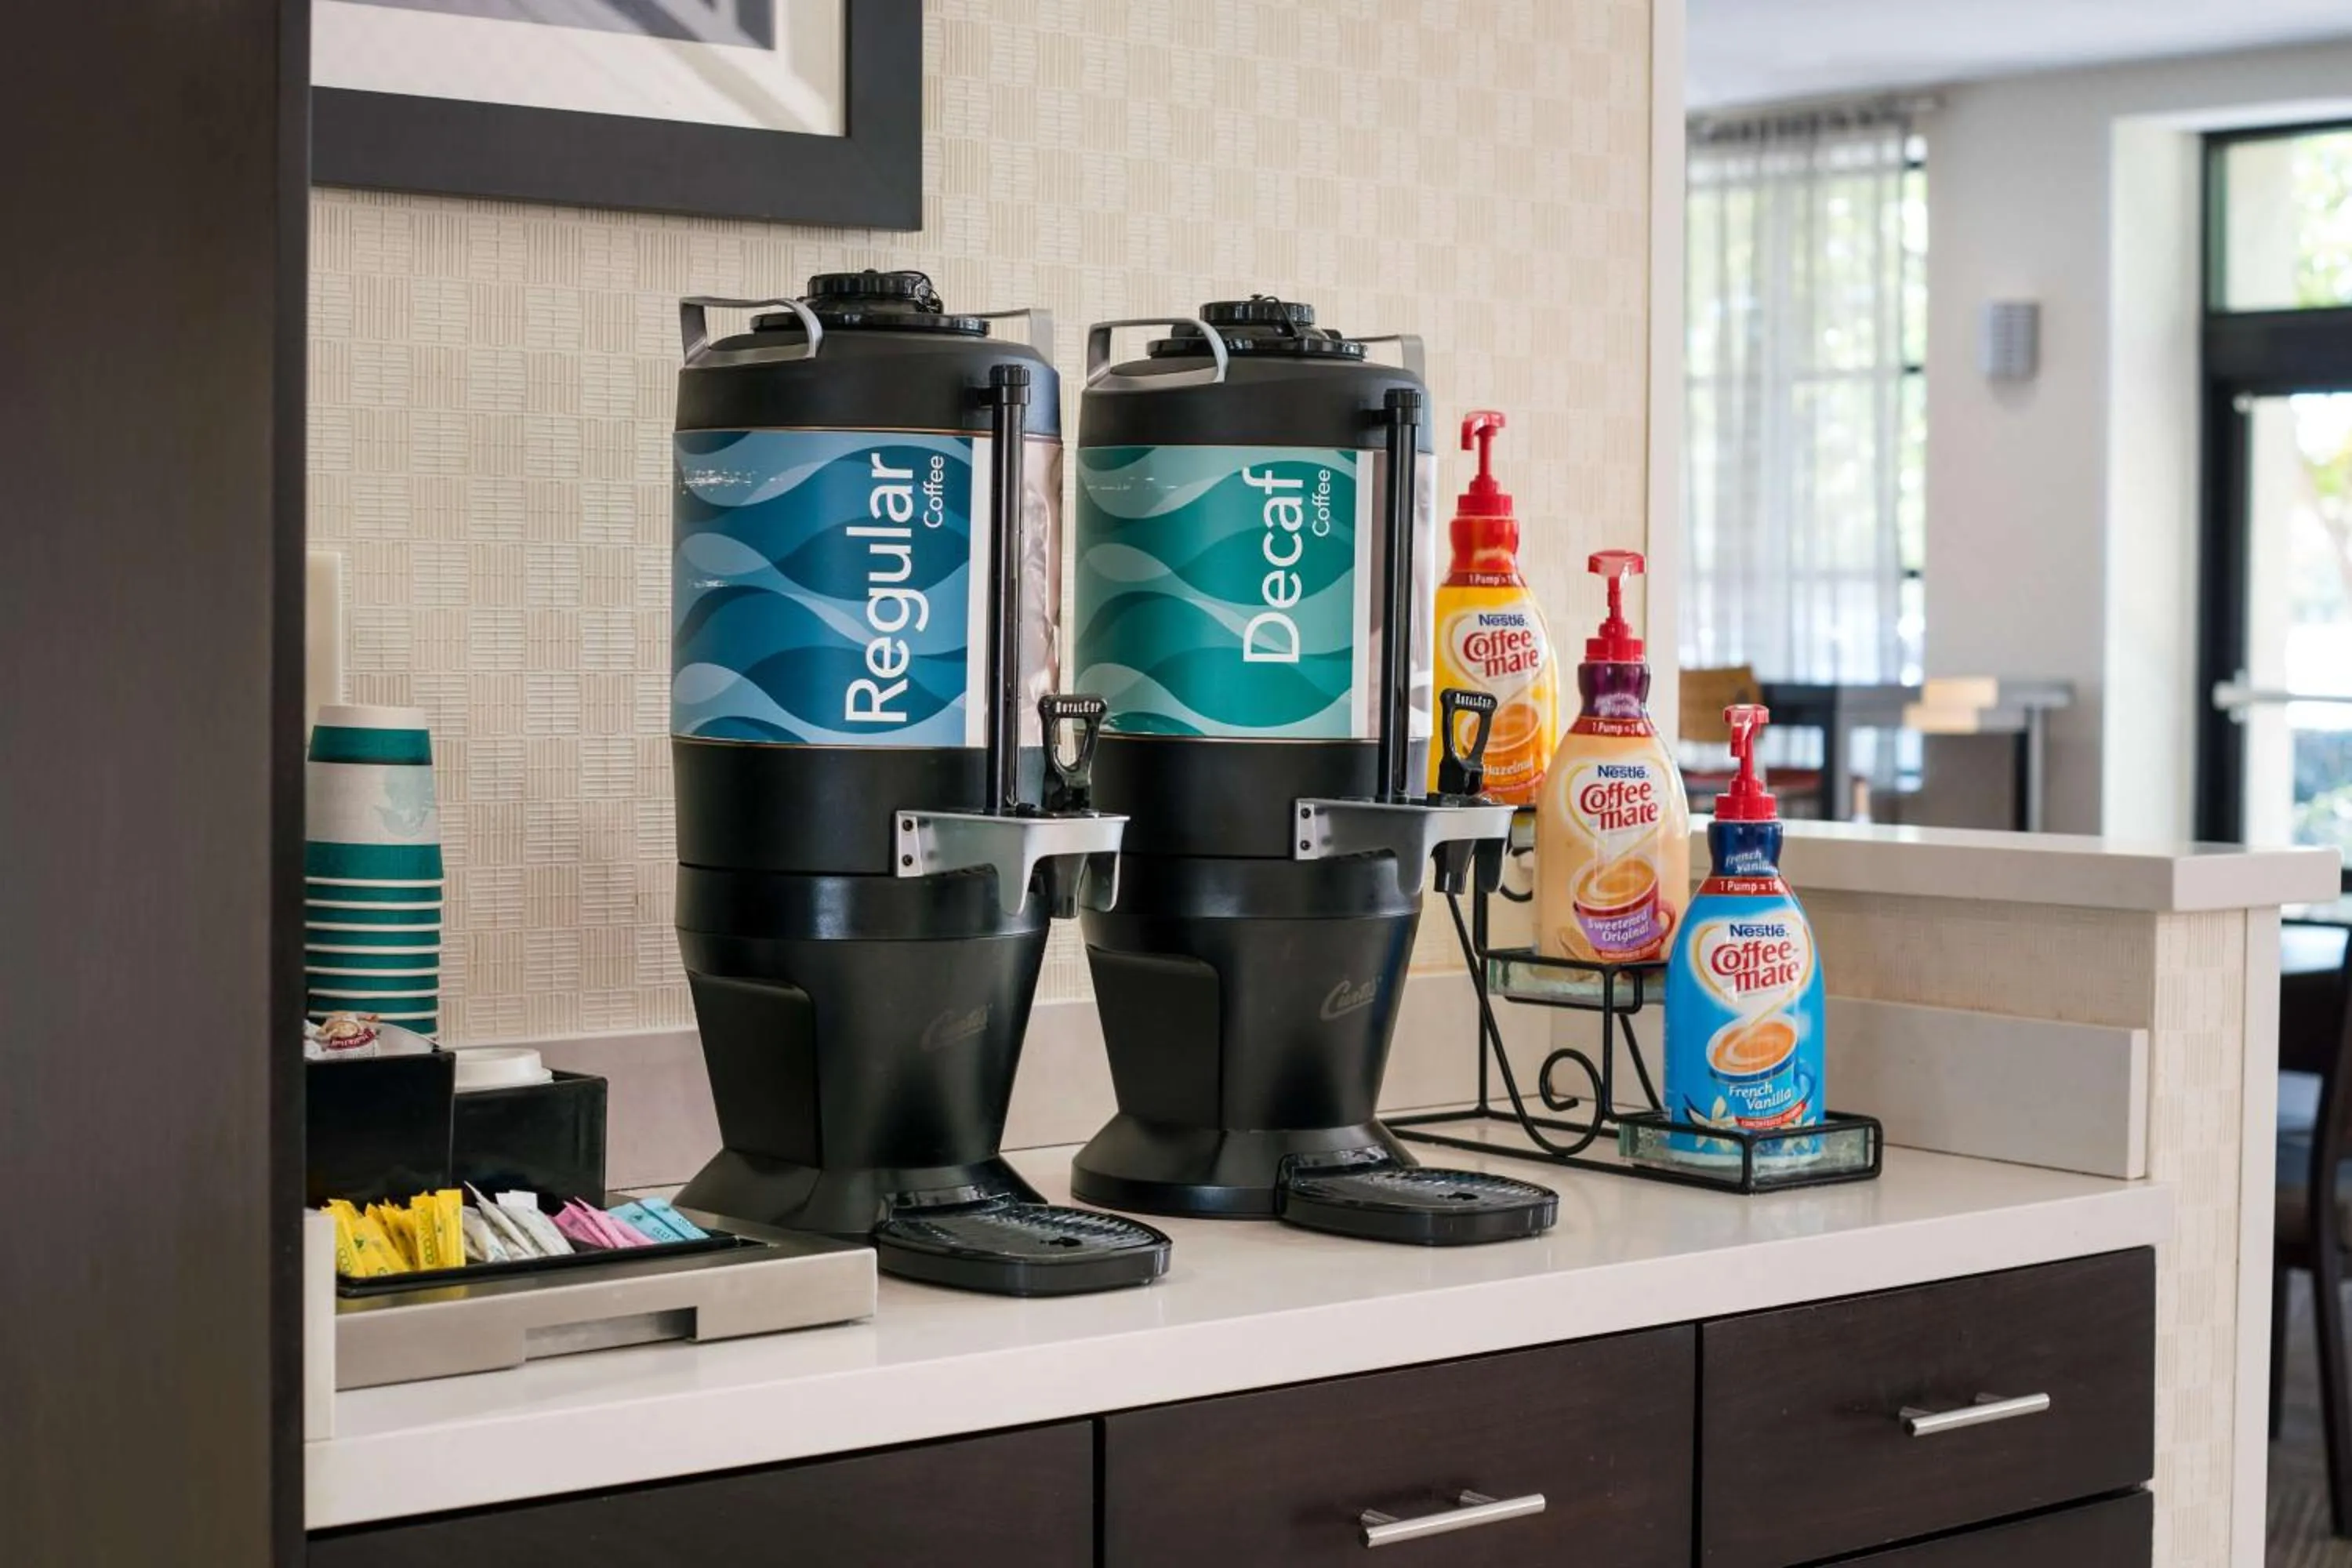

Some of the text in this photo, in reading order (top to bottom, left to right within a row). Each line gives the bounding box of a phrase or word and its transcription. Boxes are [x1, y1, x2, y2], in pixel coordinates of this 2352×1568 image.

[924, 455, 945, 528] Coffee
[1312, 468, 1331, 538] Coffee
[1243, 466, 1305, 663] Decaf
[844, 452, 929, 723] Regular
[1463, 630, 1532, 662] Coffee
[1484, 649, 1539, 678] mate
[1598, 721, 1623, 735] Pump
[1580, 782, 1652, 815] Coffee
[1599, 802, 1658, 830] mate
[1720, 880, 1725, 892] 1
[1727, 880, 1758, 896] Pump
[1587, 912, 1648, 930] Sweetened
[1602, 921, 1650, 943] Original
[1711, 940, 1793, 976] Coffee
[1734, 962, 1800, 993] mate
[1729, 1080, 1773, 1098] French
[1745, 1088, 1792, 1110] Vanilla
